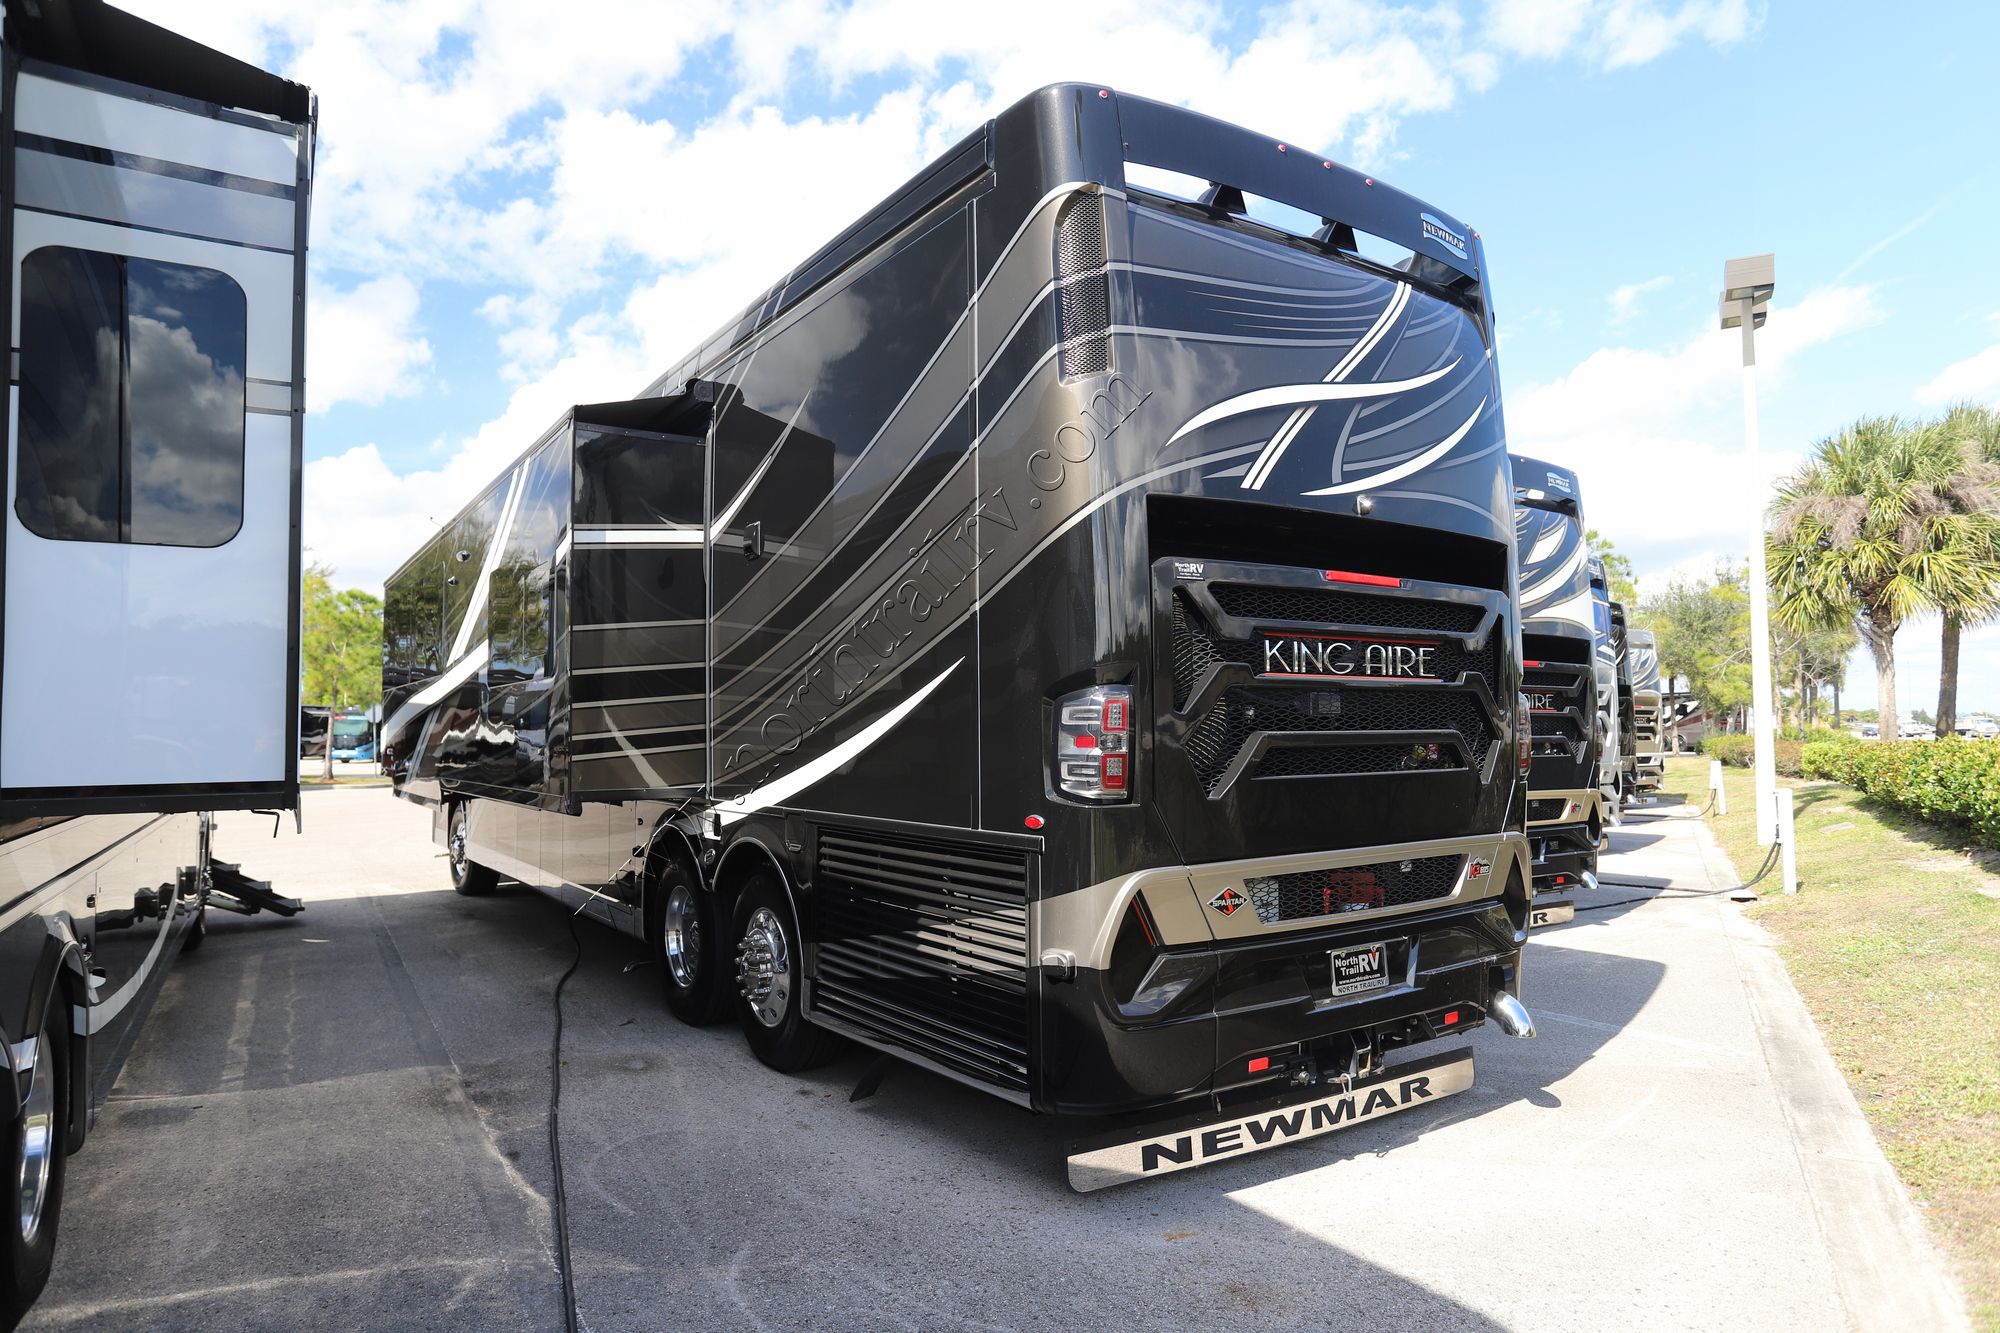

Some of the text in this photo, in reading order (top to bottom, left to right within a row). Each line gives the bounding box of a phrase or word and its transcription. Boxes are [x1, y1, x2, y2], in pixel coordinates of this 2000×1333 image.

[1423, 221, 1466, 251] NEWMAR
[1190, 563, 1204, 574] RV
[1264, 639, 1436, 677] KING AIRE
[1212, 897, 1245, 907] SPARTAN
[1334, 956, 1359, 968] North
[1358, 951, 1380, 973] RV
[1340, 964, 1360, 976] Trail
[1337, 984, 1359, 994] NORTH
[1359, 980, 1377, 989] TRAIL
[1141, 1076, 1433, 1172] NEWMAR
